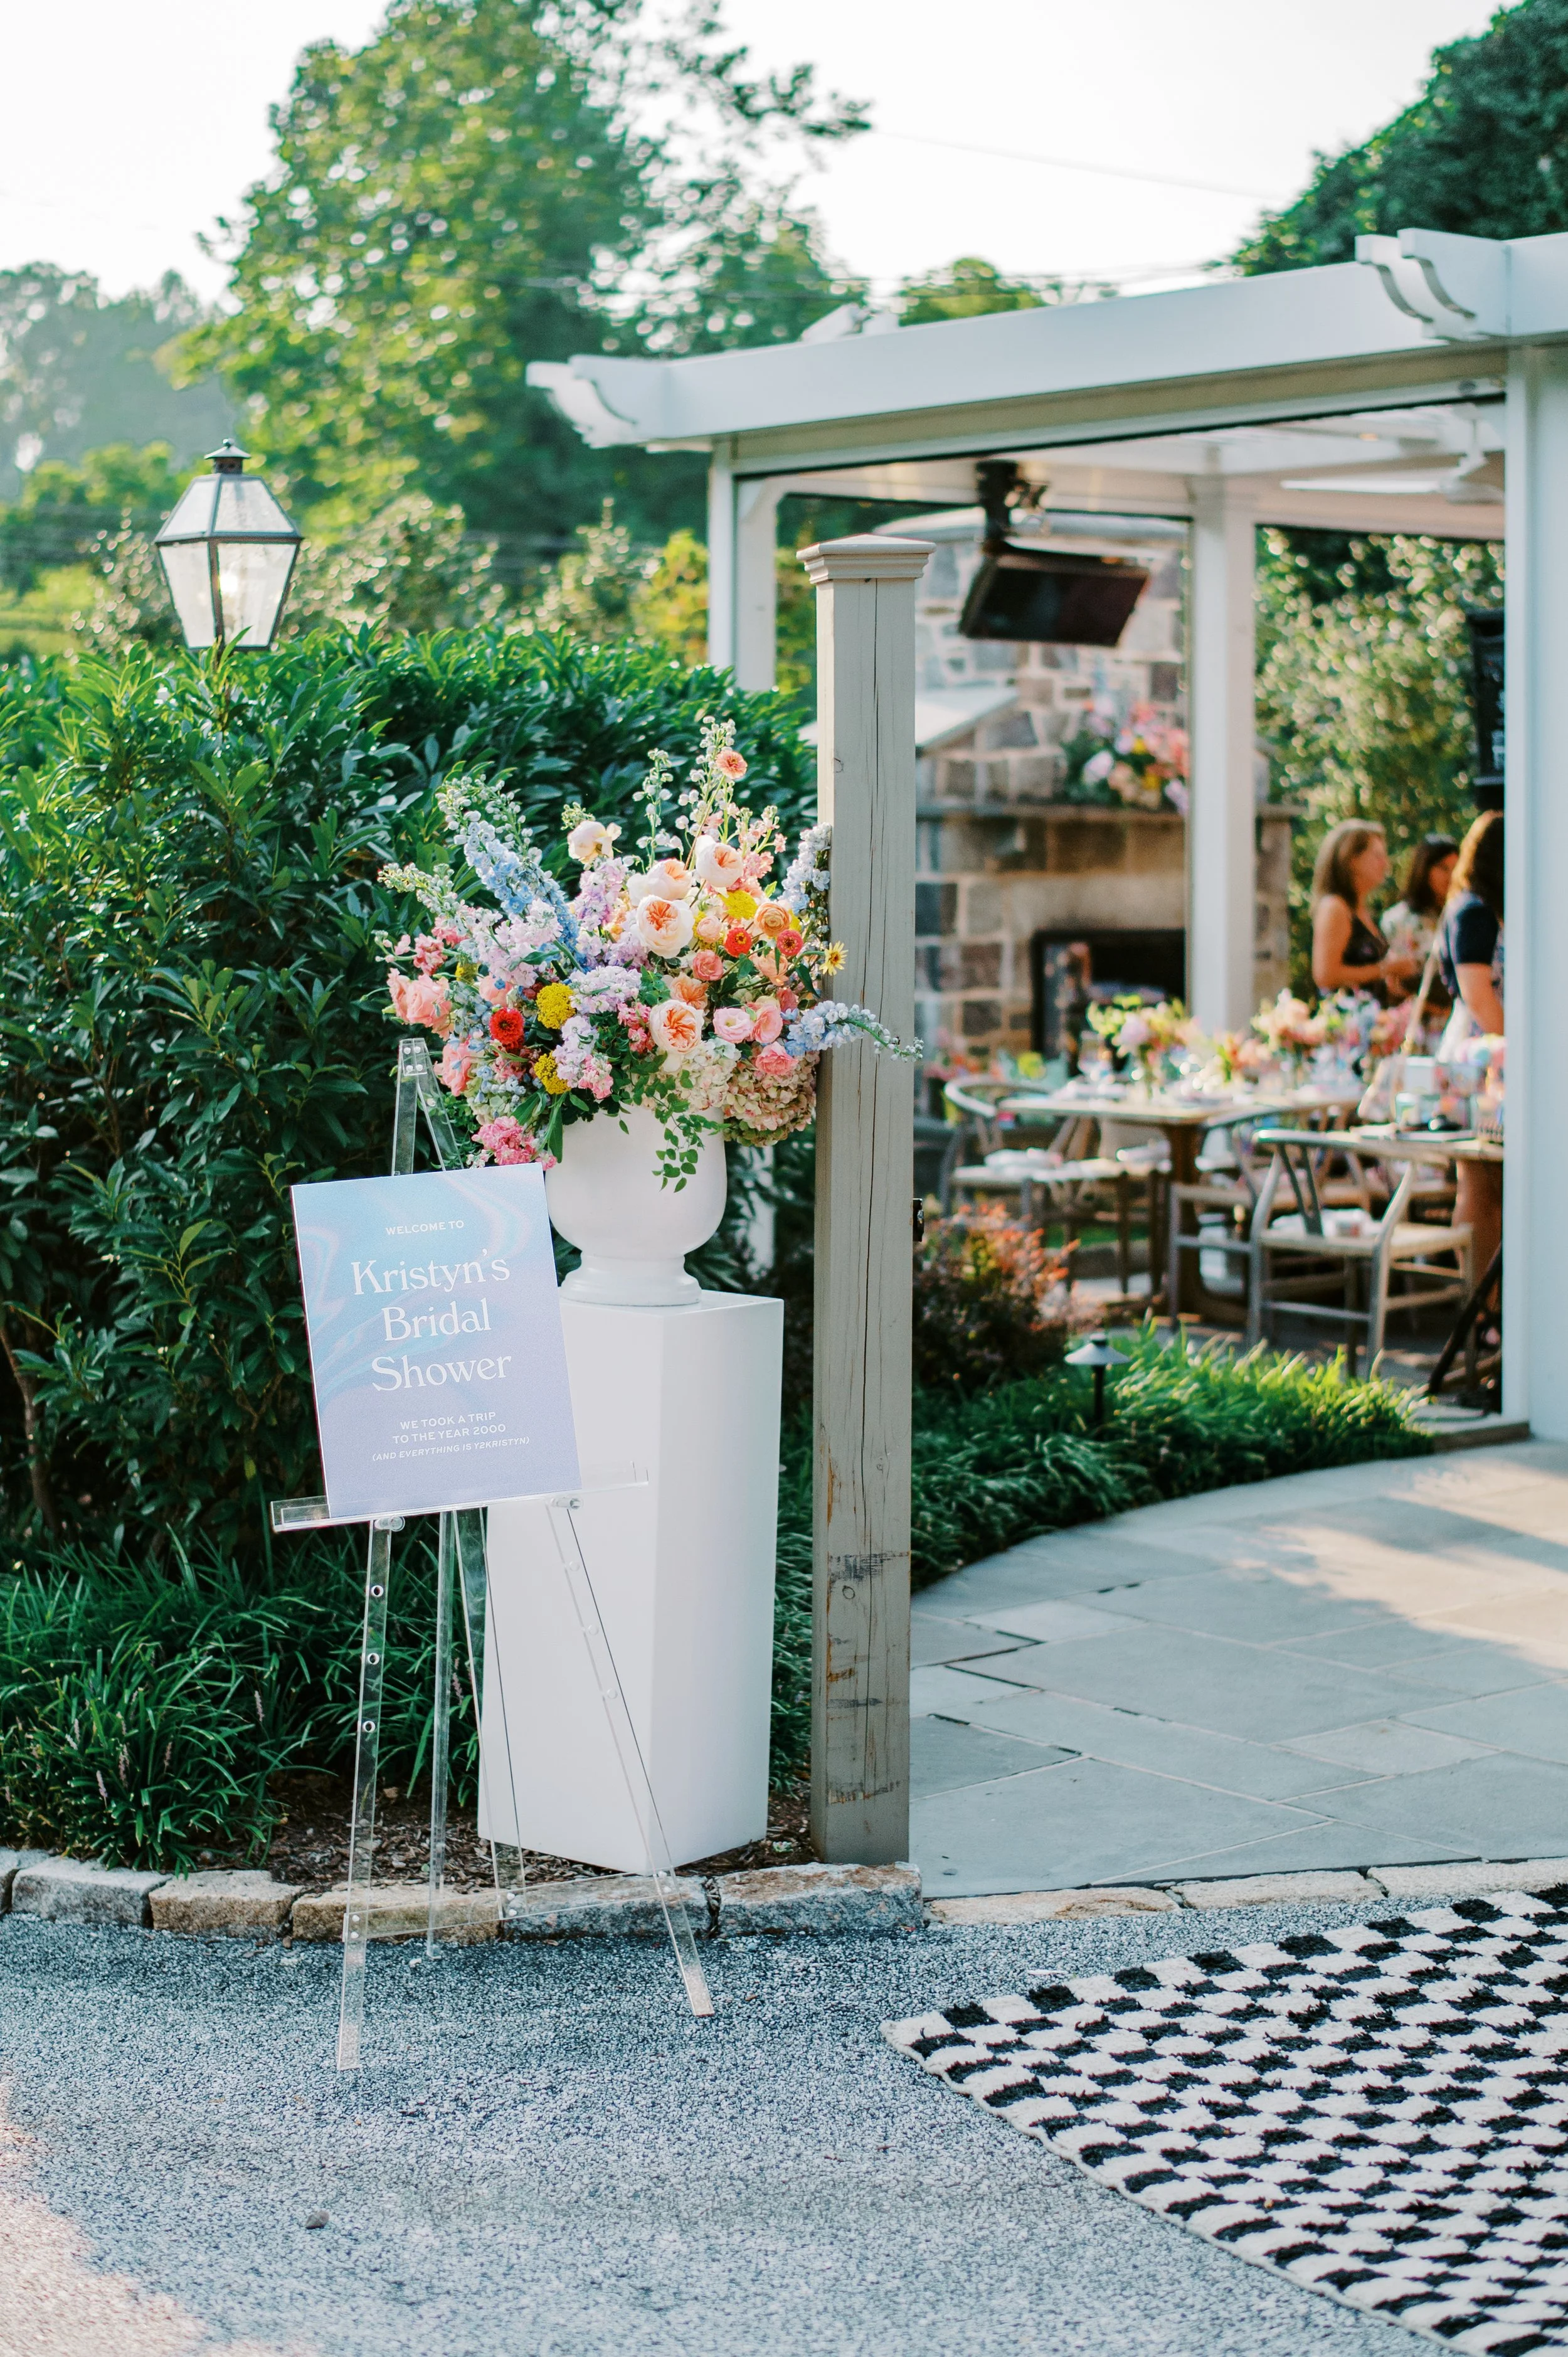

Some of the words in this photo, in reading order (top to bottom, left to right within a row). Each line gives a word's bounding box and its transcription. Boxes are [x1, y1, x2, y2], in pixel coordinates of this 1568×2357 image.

[385, 1221, 446, 1236] WELCOME
[448, 1220, 464, 1230] TO
[381, 1297, 492, 1341] Bridal
[371, 1355, 512, 1391] Shower
[400, 1420, 419, 1430] WE
[421, 1416, 455, 1428] TOOK
[458, 1415, 466, 1423] A
[468, 1412, 496, 1422] TRIP
[393, 1434, 409, 1444] TO
[411, 1431, 435, 1442] THE
[438, 1427, 470, 1439] YEAR
[473, 1423, 506, 1435] 2000
[372, 1452, 396, 1462] (AND
[399, 1444, 460, 1459] EVERYTHING
[474, 1436, 530, 1450] Y2KRISTYN)
